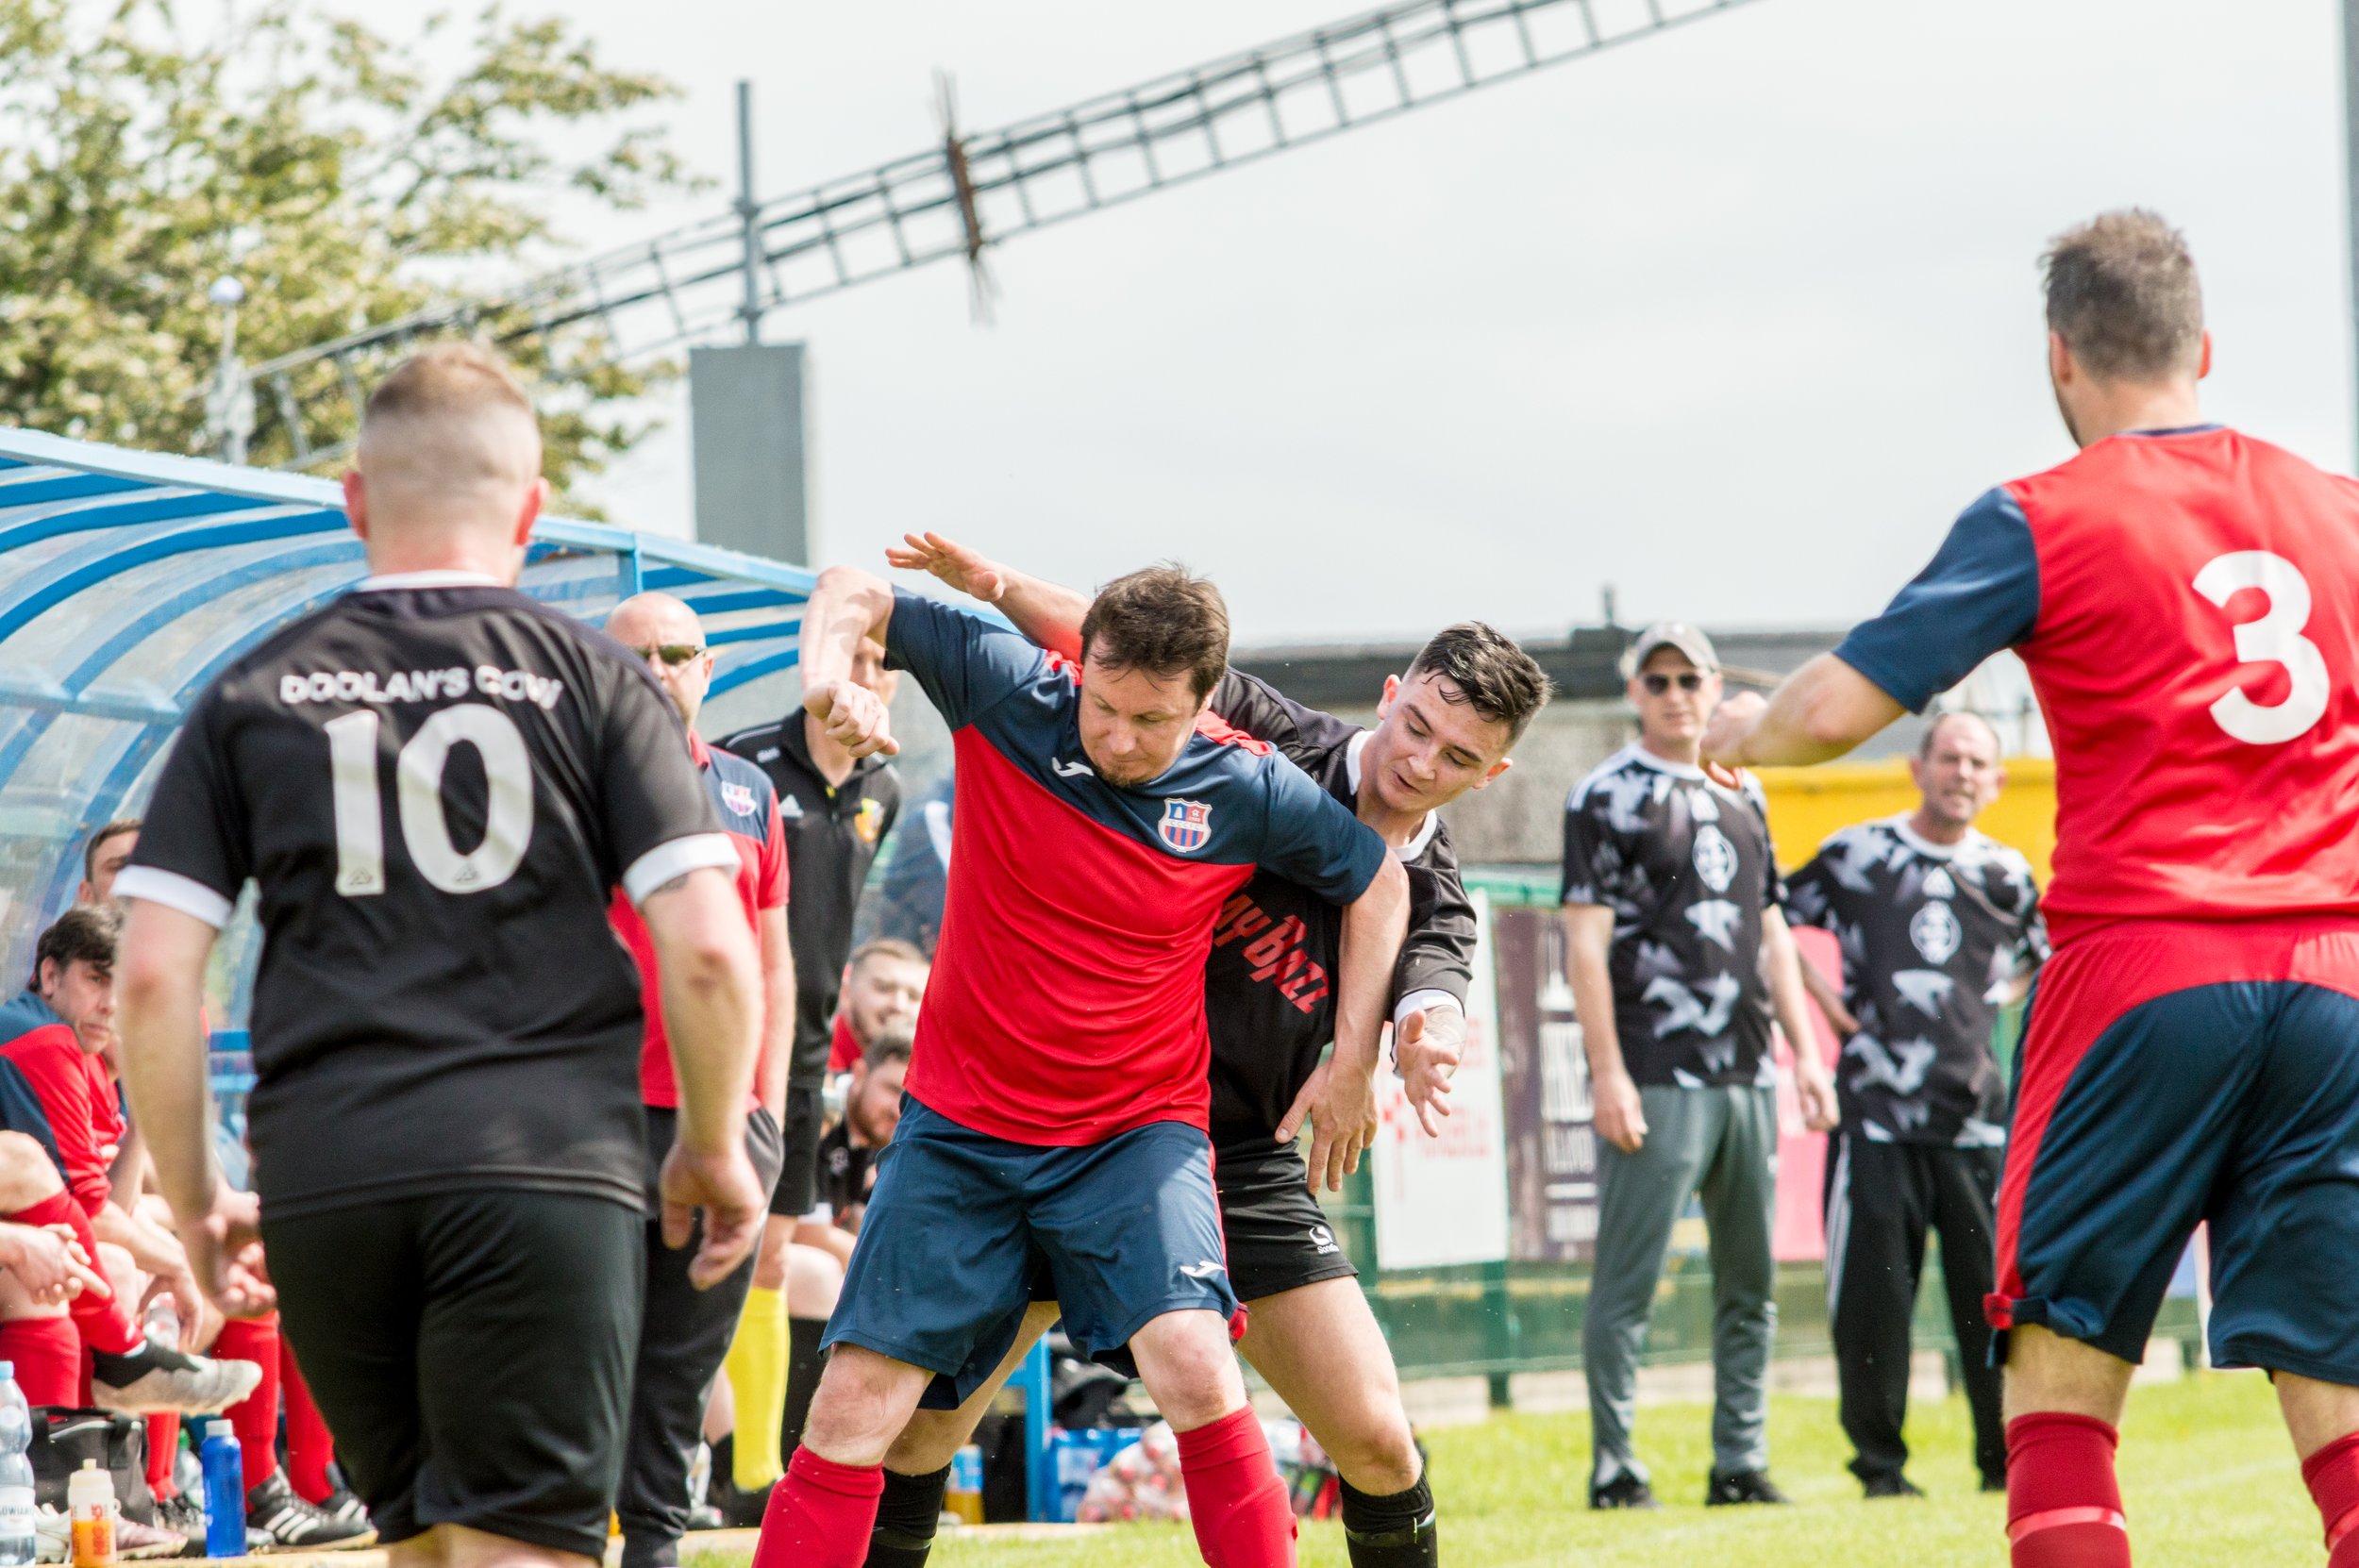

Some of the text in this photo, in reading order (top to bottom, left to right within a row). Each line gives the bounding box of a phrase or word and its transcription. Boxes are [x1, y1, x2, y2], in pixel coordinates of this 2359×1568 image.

[280, 664, 563, 709] DOOLAN'S COW
[2192, 550, 2330, 744] 3
[324, 704, 533, 894] 10
